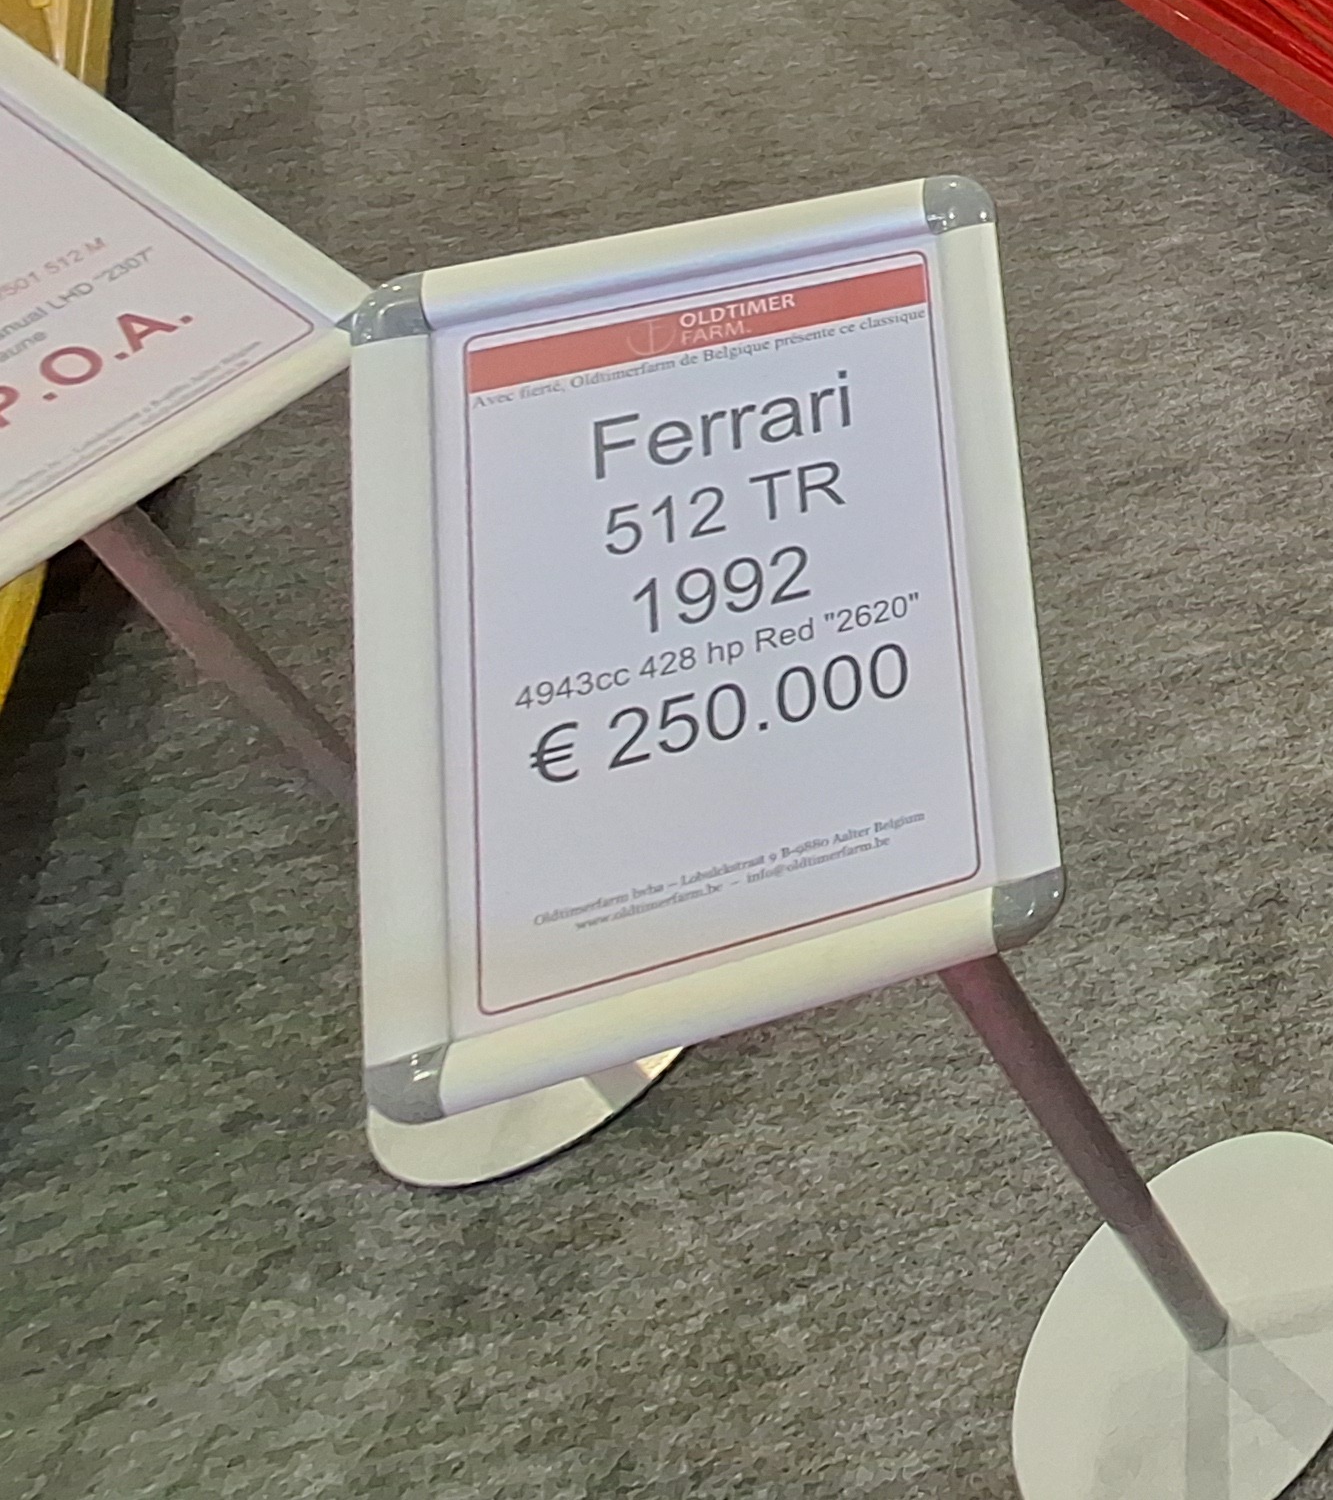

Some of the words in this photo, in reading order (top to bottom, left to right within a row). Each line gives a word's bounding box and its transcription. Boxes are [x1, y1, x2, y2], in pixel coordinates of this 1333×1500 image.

[45, 281, 95, 310] LHD
[679, 292, 796, 328] OLDTIMER
[680, 320, 752, 347] FARM.
[0, 312, 194, 429] P.O.A.
[472, 391, 515, 410] Avec
[569, 357, 676, 390] Oldtimerfarm
[679, 352, 700, 368] de
[703, 340, 771, 363] Belgique
[774, 325, 837, 352] présente
[838, 320, 857, 336] ce
[858, 307, 927, 334] classique
[592, 370, 853, 481] Ferrari
[604, 485, 728, 556] 512
[748, 460, 847, 522] TR
[633, 545, 813, 635] 1992
[514, 666, 632, 711] 4943cc
[638, 646, 698, 681] 428
[706, 640, 746, 667] hp
[754, 618, 816, 654] Red
[824, 591, 921, 635] "2620"
[529, 720, 580, 784] €
[606, 642, 910, 771] 250.000
[832, 825, 872, 845] Aalter
[874, 812, 926, 834] Belgium
